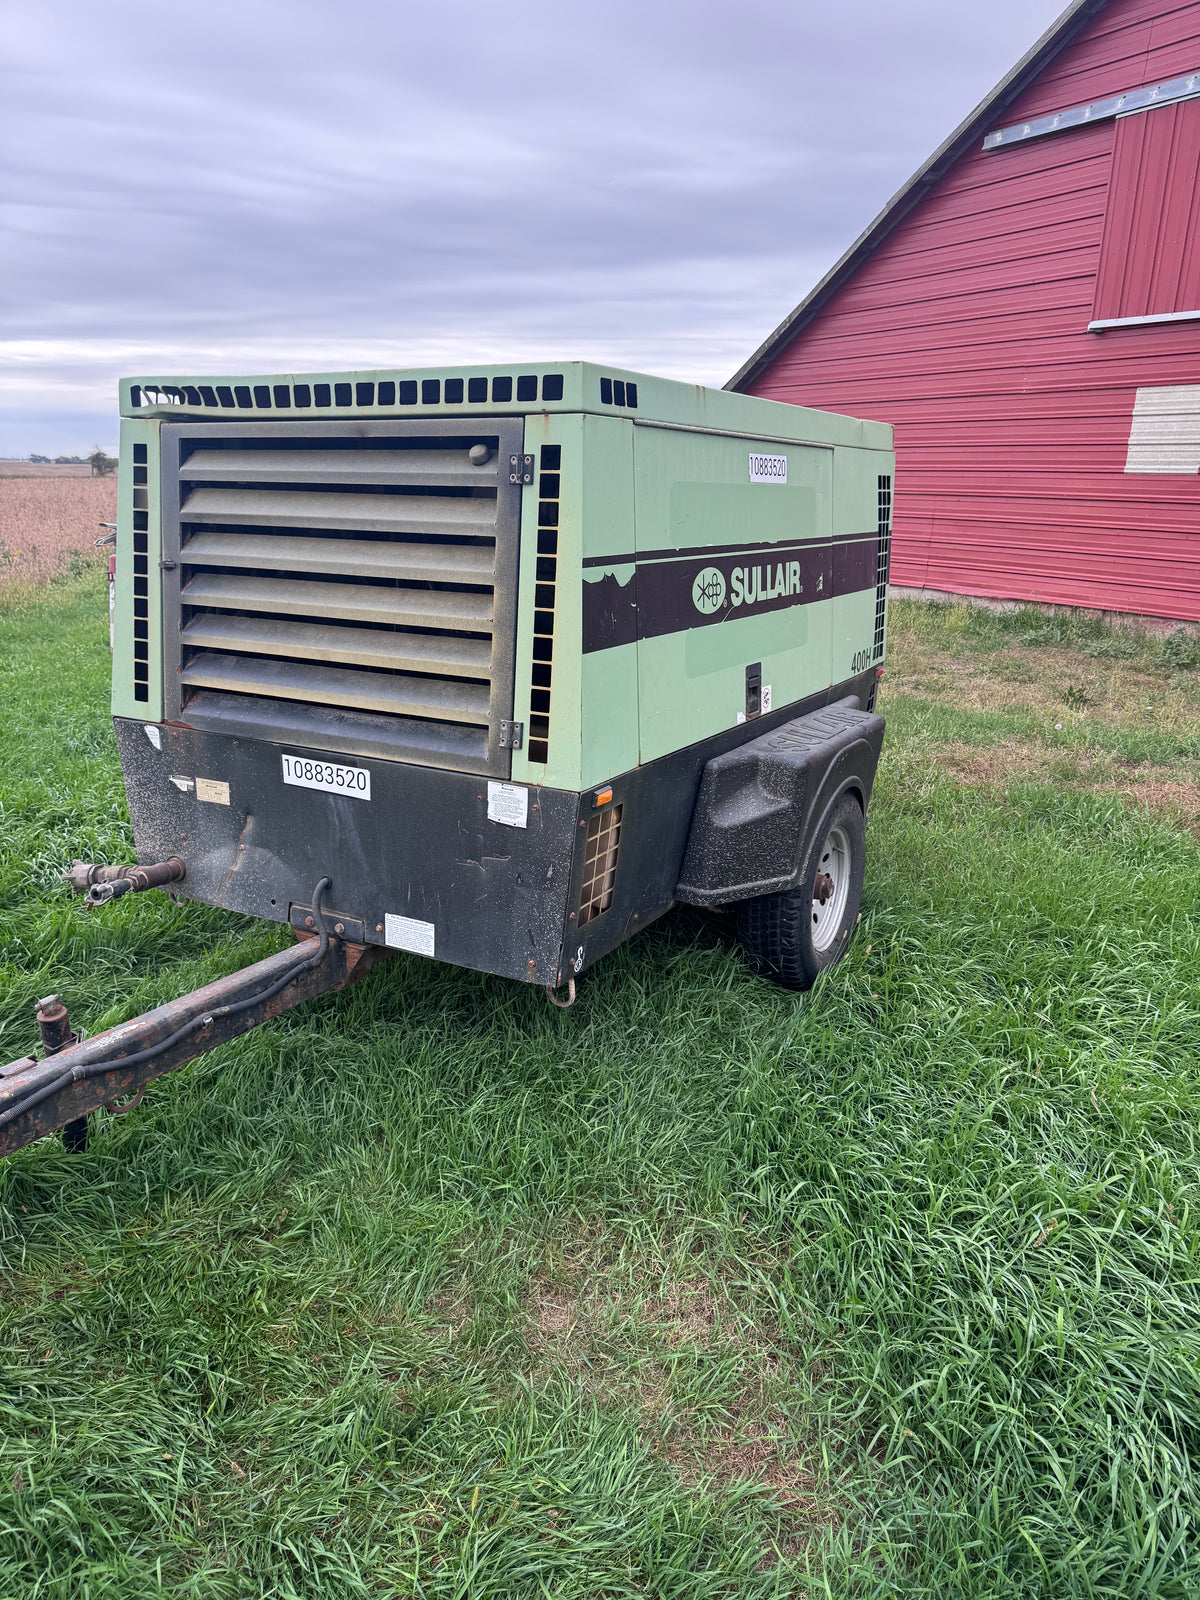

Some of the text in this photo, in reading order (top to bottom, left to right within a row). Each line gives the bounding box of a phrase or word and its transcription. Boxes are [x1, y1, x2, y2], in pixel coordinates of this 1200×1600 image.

[750, 456, 786, 477] 10883520
[730, 561, 801, 607] SULLAIR
[851, 646, 872, 675] 400H
[284, 758, 367, 791] 10883520
